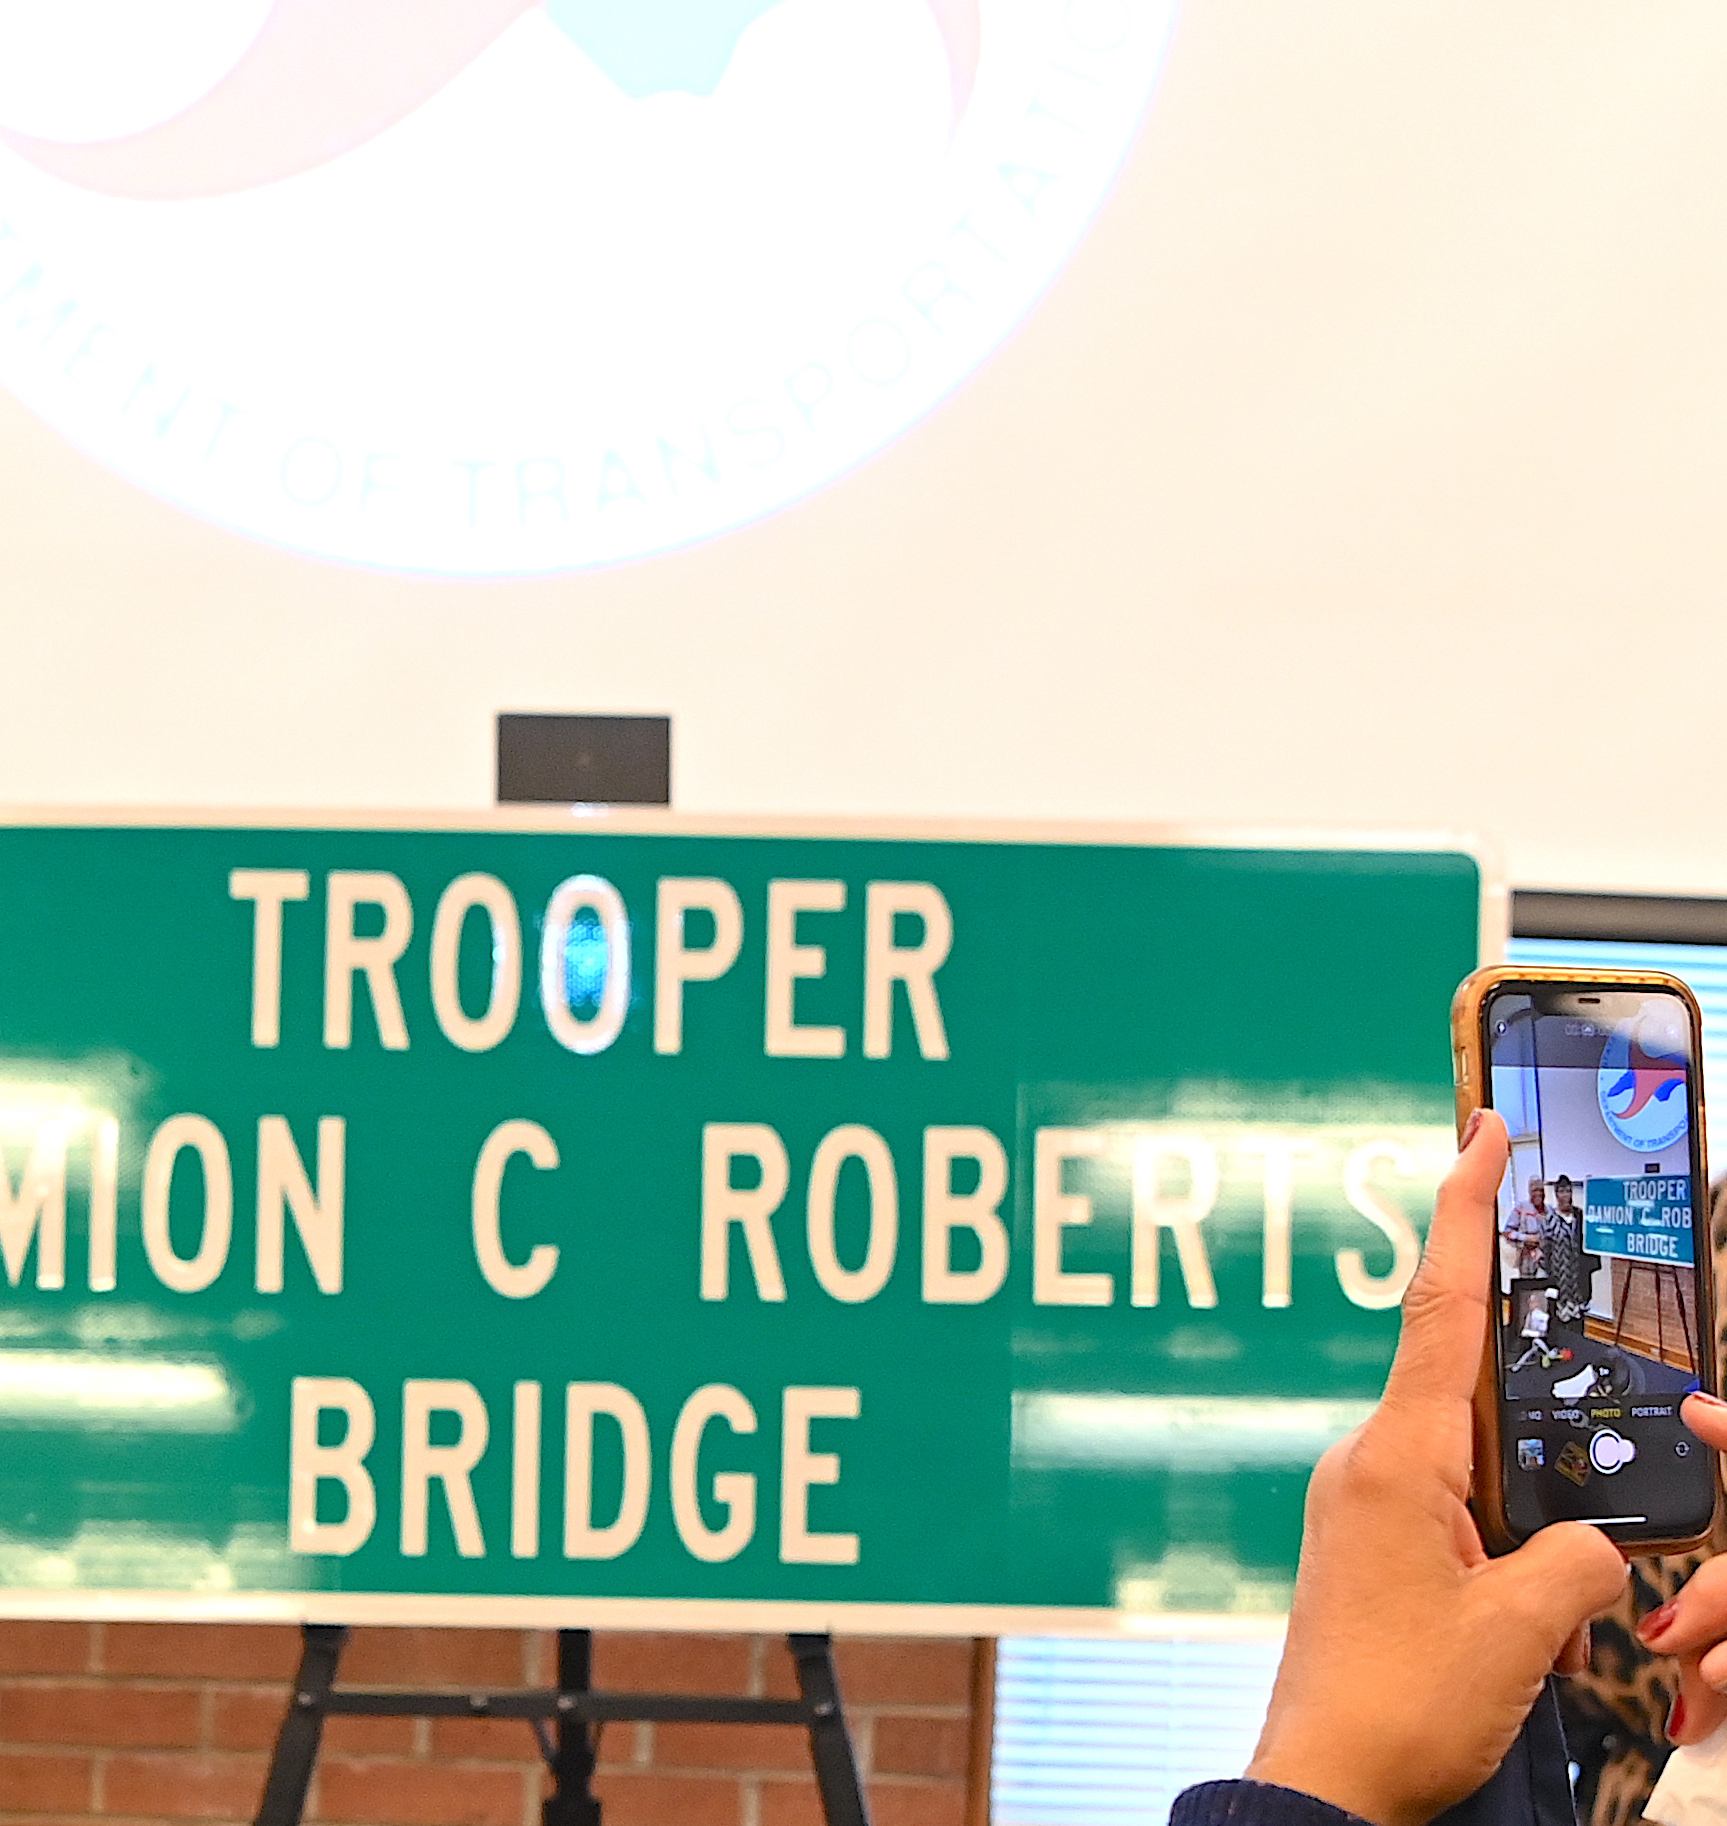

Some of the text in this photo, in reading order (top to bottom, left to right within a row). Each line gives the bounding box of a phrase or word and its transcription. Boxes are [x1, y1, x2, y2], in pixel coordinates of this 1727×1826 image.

[279, 435, 403, 513] OF
[229, 868, 956, 1060] TROOPER
[471, 1119, 561, 1298] C
[699, 1121, 1424, 1310] ROBERTS
[1623, 1179, 1687, 1201] TROOPER
[1587, 1205, 1634, 1225] DAMION
[1661, 1207, 1692, 1228] ROB
[1627, 1233, 1679, 1258] BRIDGE
[1591, 1407, 1621, 1418] PHOTO
[1631, 1406, 1673, 1417] PORTRAIT
[288, 1376, 862, 1567] BRIDGE
